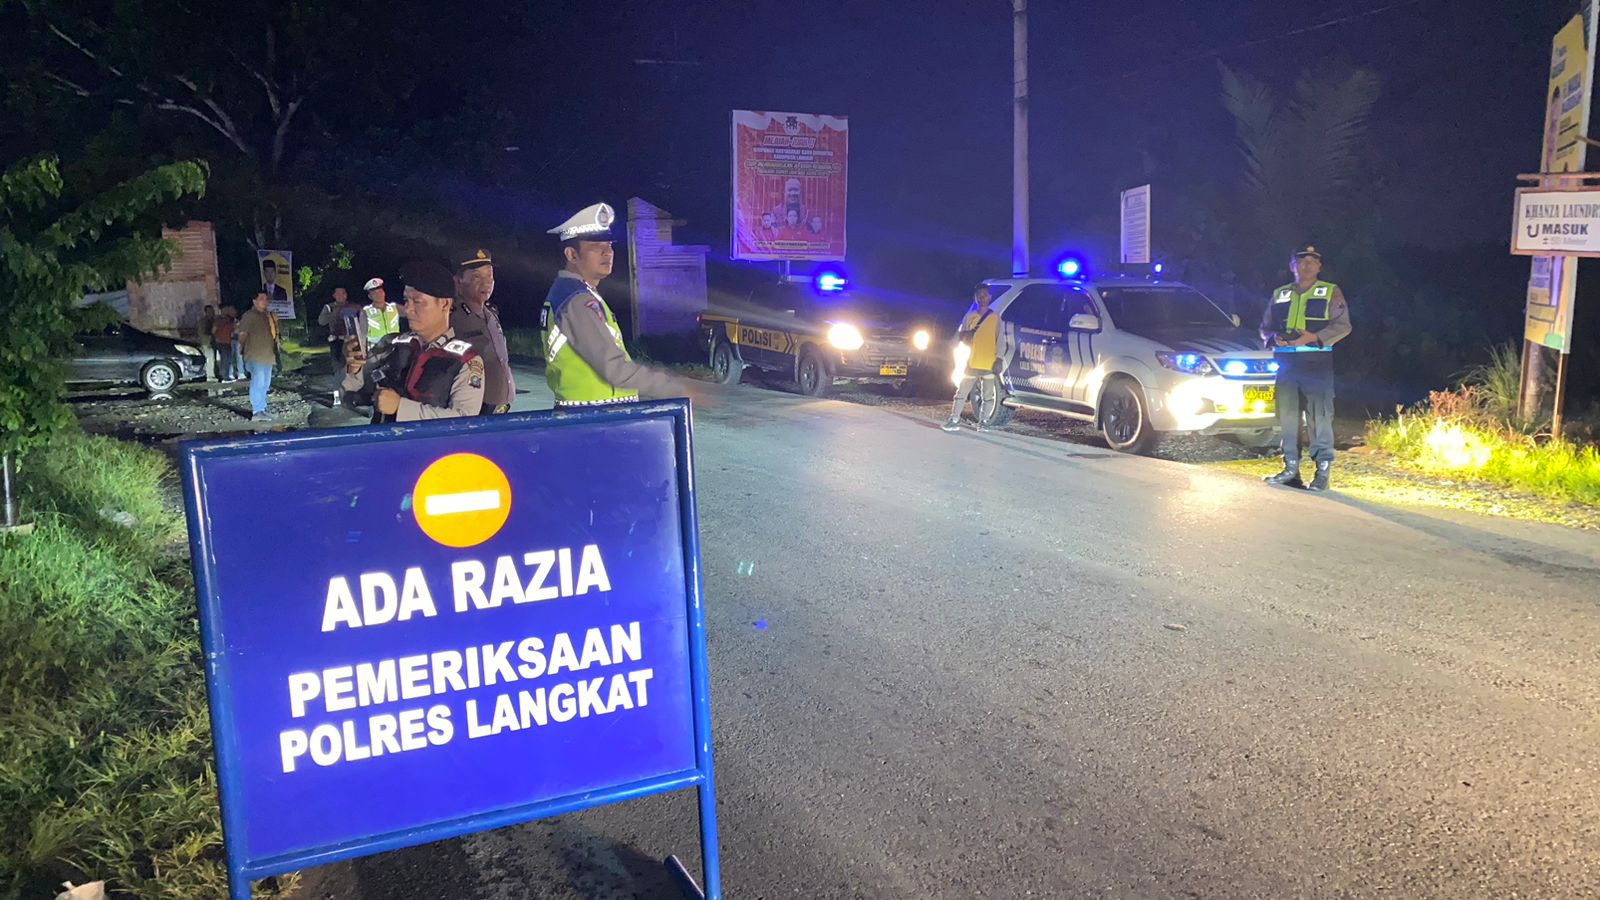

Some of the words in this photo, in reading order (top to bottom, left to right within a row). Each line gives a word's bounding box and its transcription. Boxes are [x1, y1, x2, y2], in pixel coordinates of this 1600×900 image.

[1525, 204, 1560, 218] KHANZA
[1563, 203, 1600, 218] LAUNDR
[1542, 223, 1589, 235] MASUK
[742, 327, 772, 347] POLISI
[322, 567, 438, 632] ADA
[451, 544, 612, 613] RAZIA
[289, 621, 642, 718] PEMERIKSAAN
[280, 704, 454, 773] POLRES
[466, 668, 654, 739] LANGKAT
